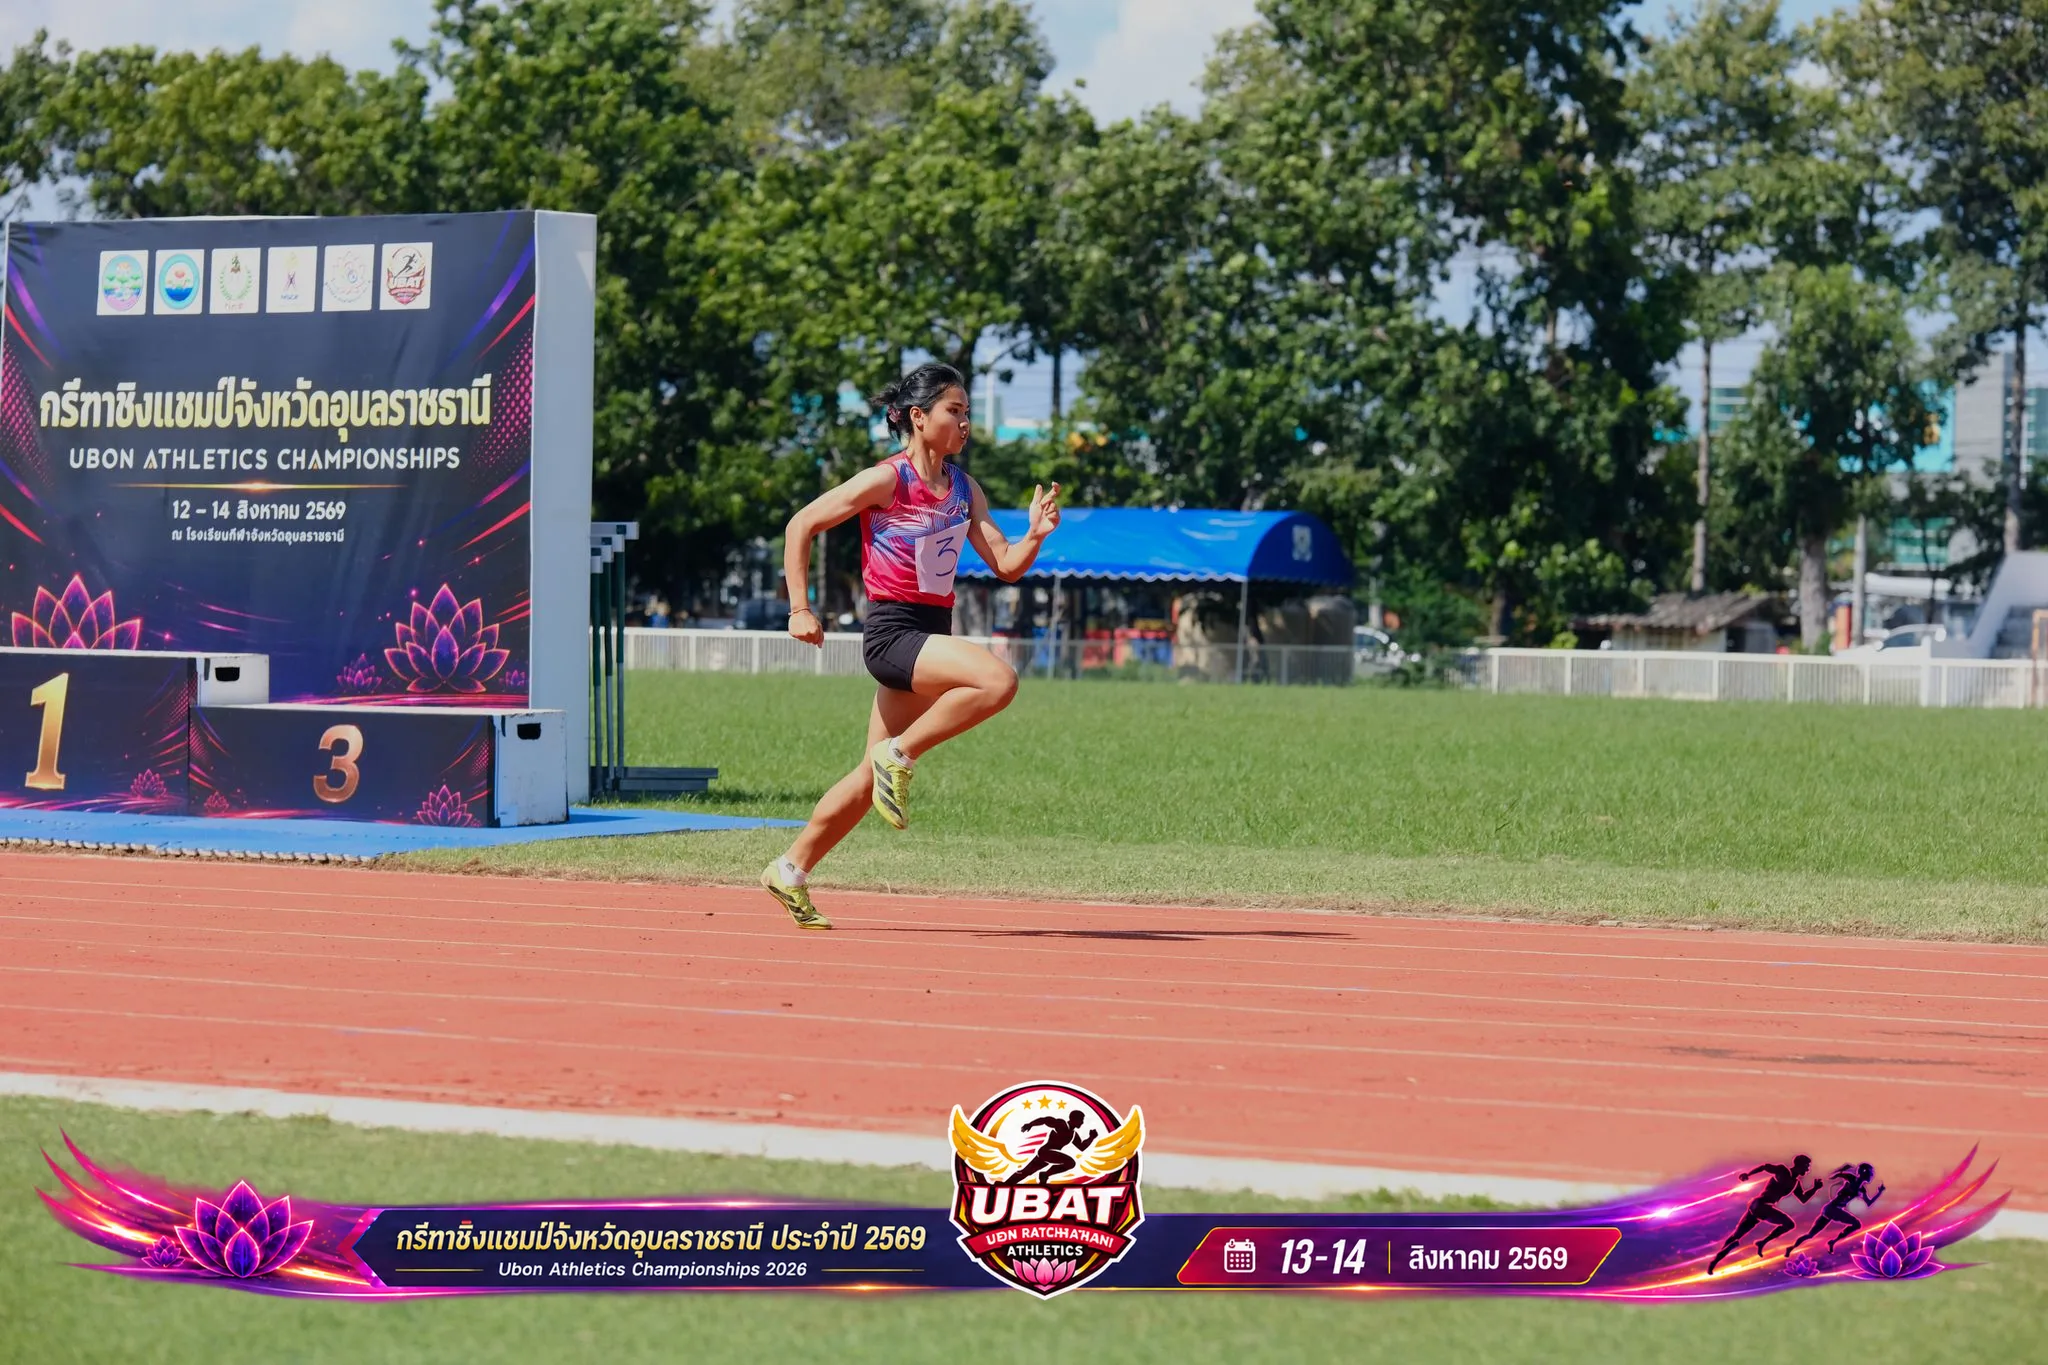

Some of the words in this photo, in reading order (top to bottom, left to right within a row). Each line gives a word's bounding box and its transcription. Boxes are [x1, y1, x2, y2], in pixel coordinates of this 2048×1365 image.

[40, 373, 492, 443] กรีฑาชิงแชมป์จังหวัดอุบลราชธานี
[69, 447, 134, 469] UBON
[143, 447, 268, 470] ATHLETICS
[277, 447, 460, 470] CHAMPIONSHIPS
[172, 500, 190, 519] 12
[212, 500, 230, 519] 14
[236, 499, 300, 520] สิงหาคม
[305, 501, 347, 520] 2569
[936, 536, 958, 577] 3
[25, 672, 69, 790] 1
[313, 724, 364, 803] 3
